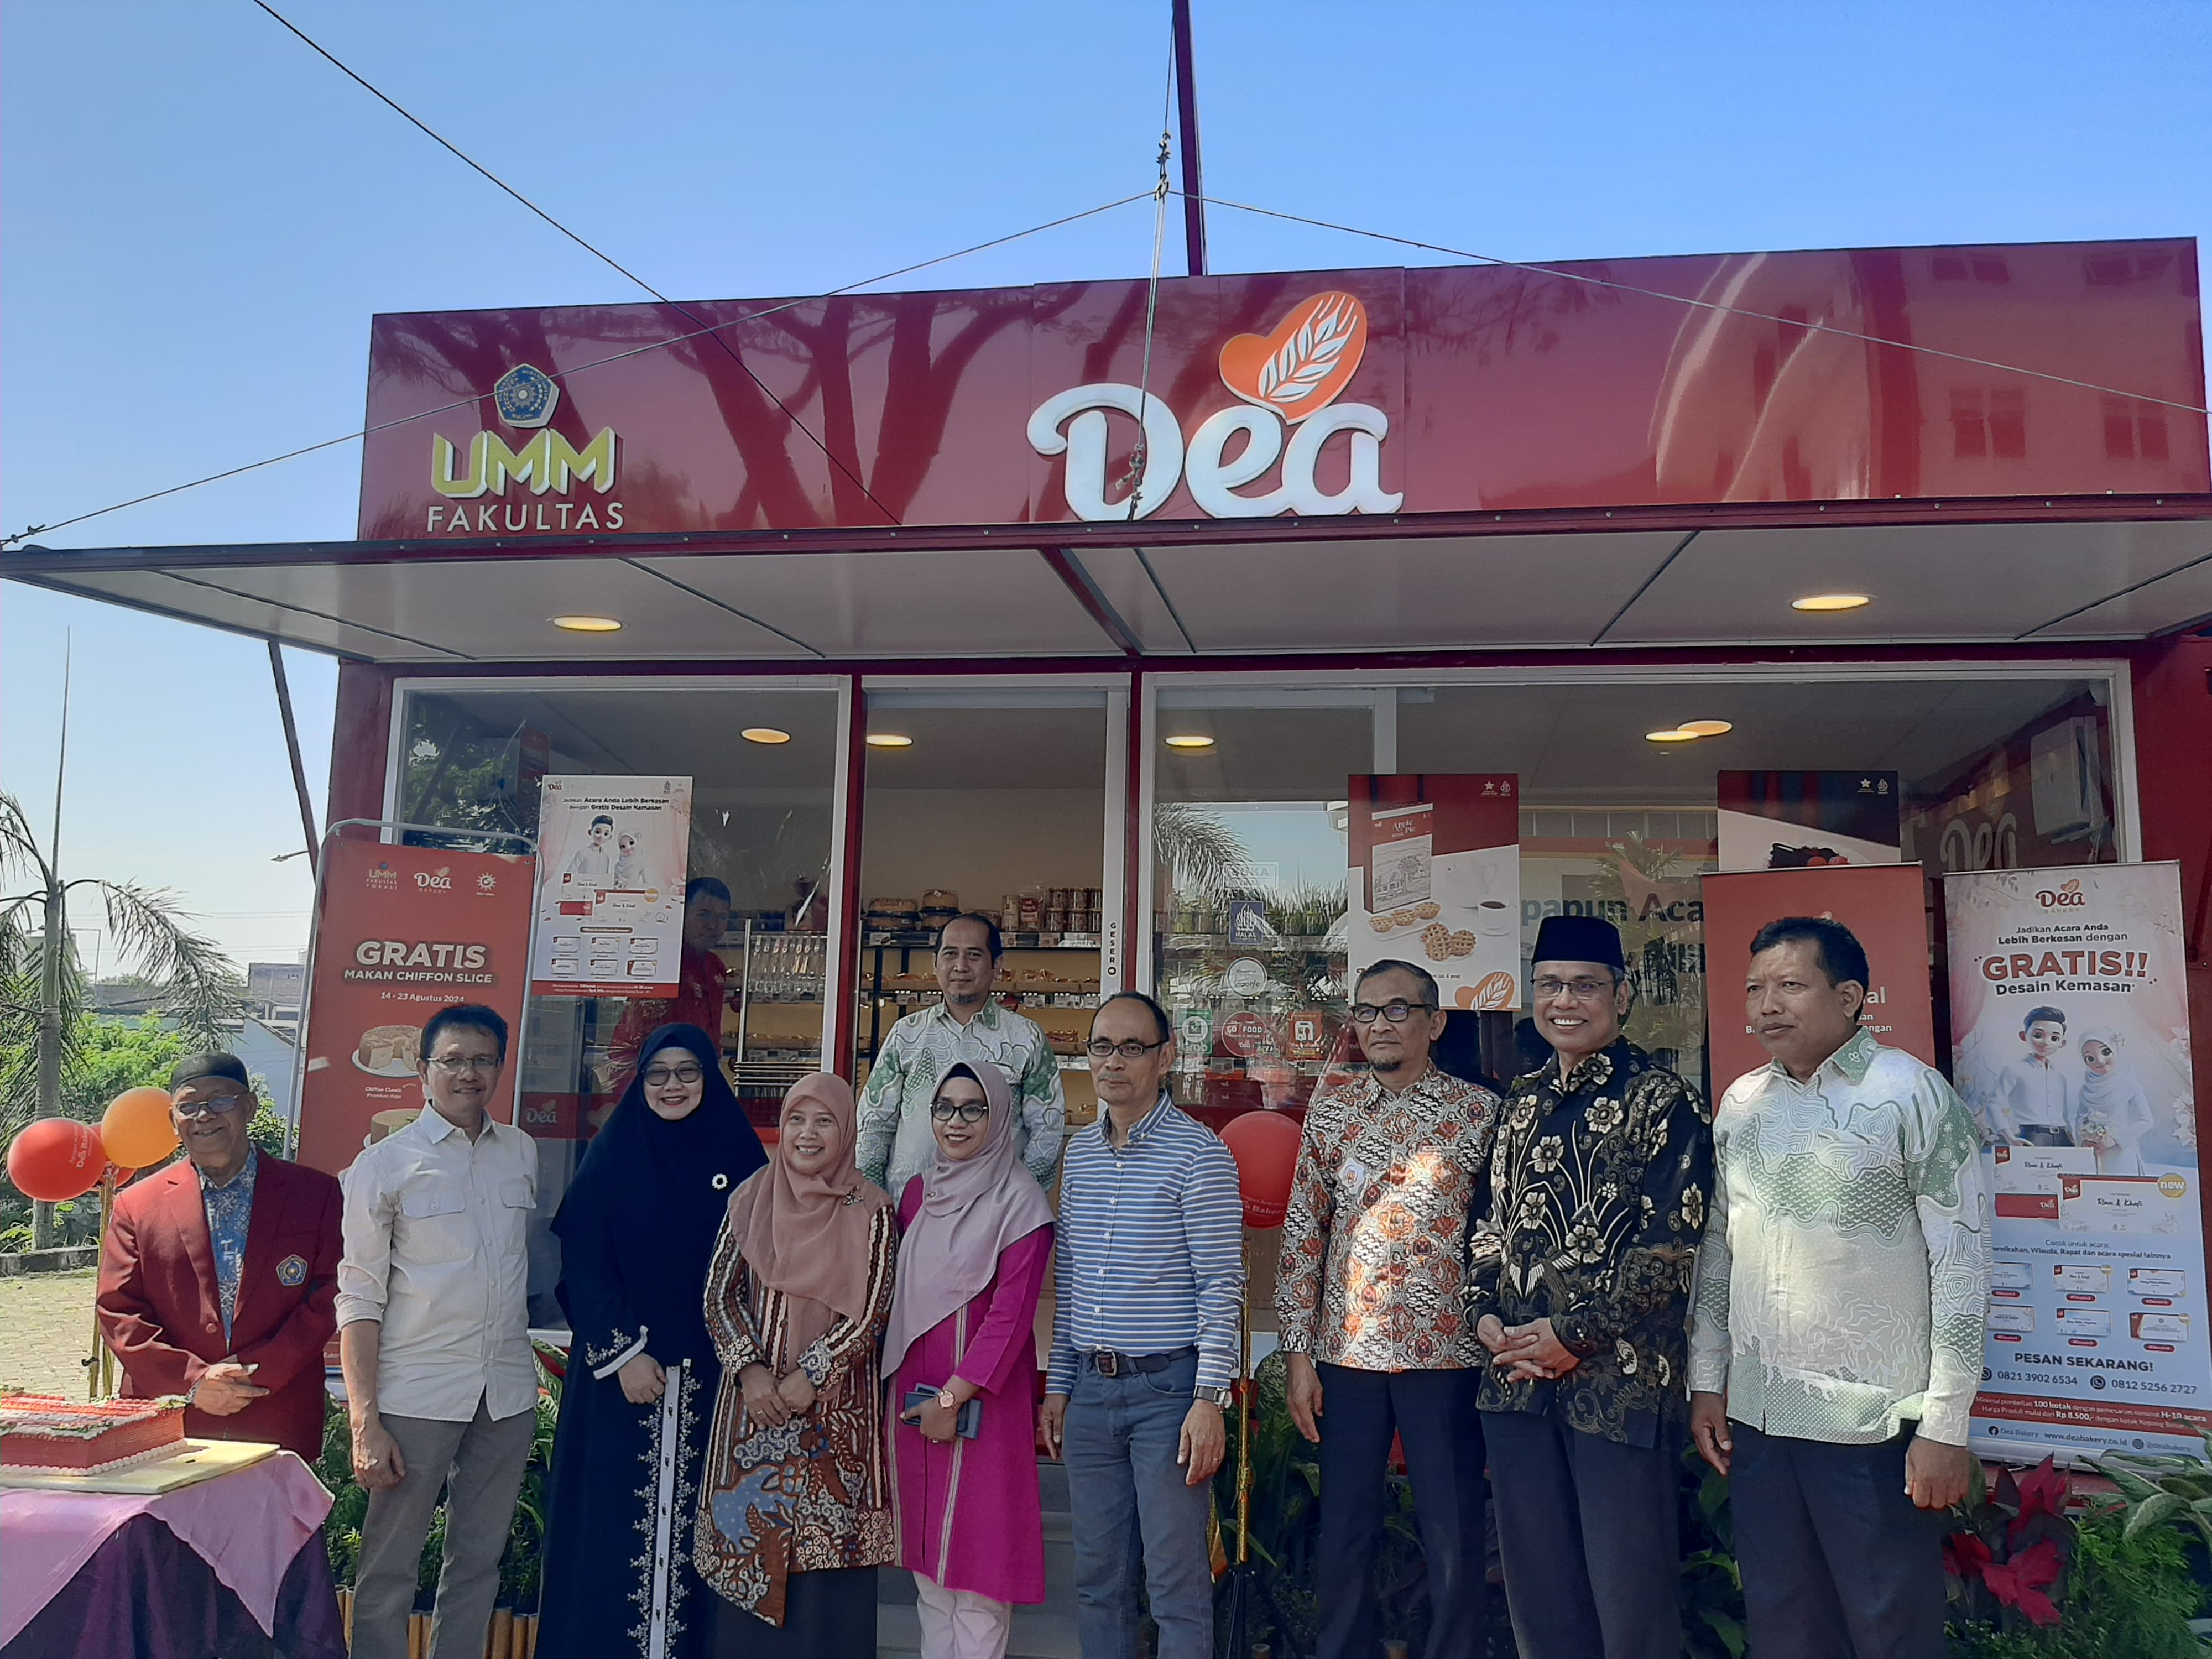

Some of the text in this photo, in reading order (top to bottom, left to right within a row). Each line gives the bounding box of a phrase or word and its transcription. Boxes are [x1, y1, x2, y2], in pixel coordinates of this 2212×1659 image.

[1027, 383, 1404, 521] Dea
[431, 426, 615, 498] UMM
[427, 502, 624, 531] FAKULTAS
[1940, 813, 2017, 872] Dea
[369, 869, 397, 879] UMM
[414, 872, 452, 889] Dea
[2035, 890, 2085, 907] Dea
[1998, 933, 2127, 945] Lebih Berkesan dengan
[356, 941, 486, 968] GRATIS
[1983, 951, 2147, 980] GRATIS!!
[344, 969, 492, 983] MAKAN CHIFFON SLICE
[1996, 980, 2131, 995] Desain Kemasan
[409, 994, 442, 1002] Agustus
[525, 1108, 557, 1124] Dea
[2060, 1249, 2080, 1257] Rapat
[2118, 1251, 2142, 1259] spesial
[2015, 1353, 2154, 1372] PESAN SEKARANG!
[1997, 1371, 2078, 1385] 0821 3902 6534
[2111, 1380, 2197, 1394] 0812 5256 2727
[2056, 1411, 2067, 1419] Rp
[2015, 1428, 2039, 1437] Bakery
[2044, 1432, 2127, 1446] www.deabakery.co.id
